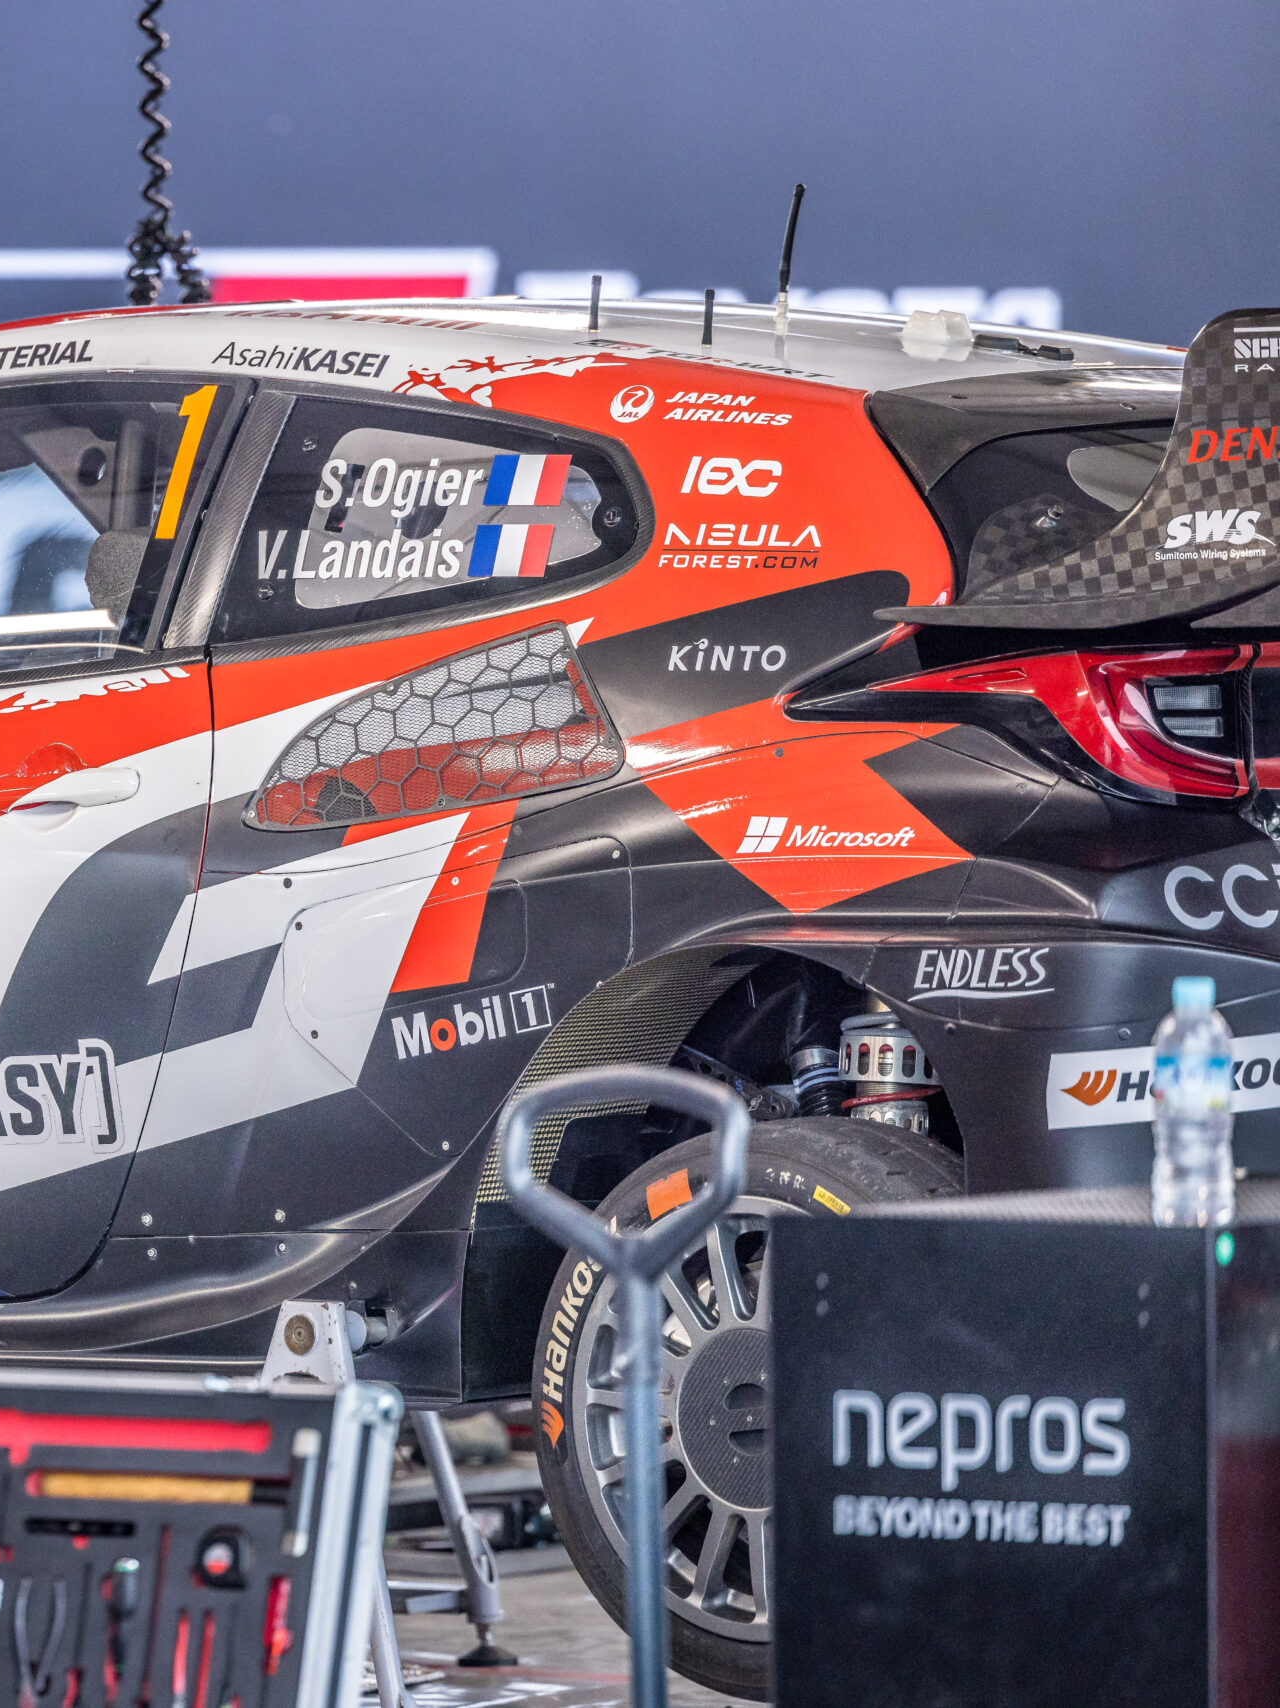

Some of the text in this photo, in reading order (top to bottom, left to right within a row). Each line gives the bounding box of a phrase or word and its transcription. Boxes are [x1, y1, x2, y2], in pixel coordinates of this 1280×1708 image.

[211, 341, 391, 378] AsahiKASEI
[663, 407, 793, 426] AIRLINES
[665, 391, 756, 407] JAPAN
[154, 384, 218, 539] 1
[1187, 426, 1280, 464] DEN
[315, 458, 484, 518] S.Ogier
[1163, 508, 1262, 549] SWS
[257, 528, 464, 580] V.Landais
[658, 554, 819, 569] FOREST.COM
[1154, 548, 1266, 561] Sumitomo Wiring Systems
[786, 825, 916, 848] Microsoft
[913, 947, 1050, 989] ENDLESS
[390, 995, 507, 1060] Mobil
[520, 991, 537, 1027] 1
[832, 1389, 1131, 1492] nepros
[832, 1494, 1132, 1547] BEYOND THE BEST
